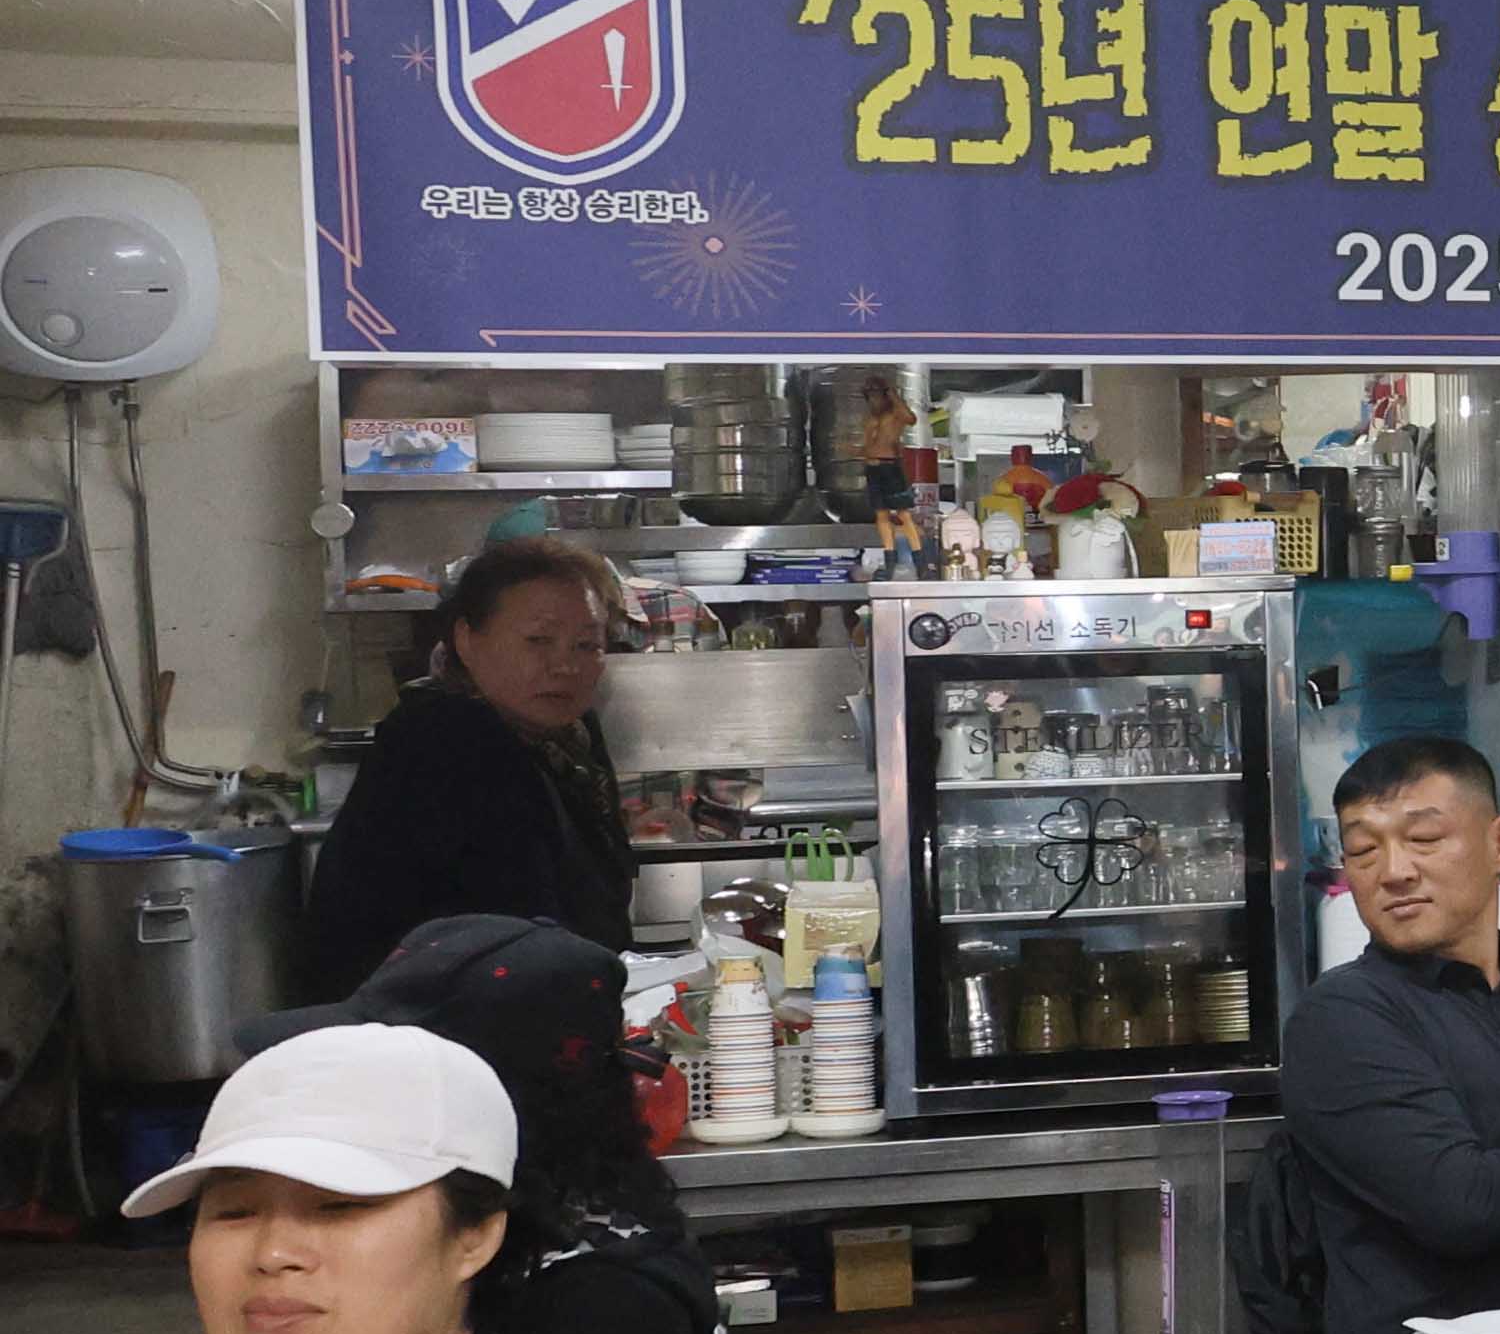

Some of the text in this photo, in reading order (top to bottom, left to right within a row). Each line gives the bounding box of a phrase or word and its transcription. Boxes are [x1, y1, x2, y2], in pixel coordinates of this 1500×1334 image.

[424, 186, 707, 221] 우리는 항상 승리한다.
[1069, 616, 1137, 640] 소독기
